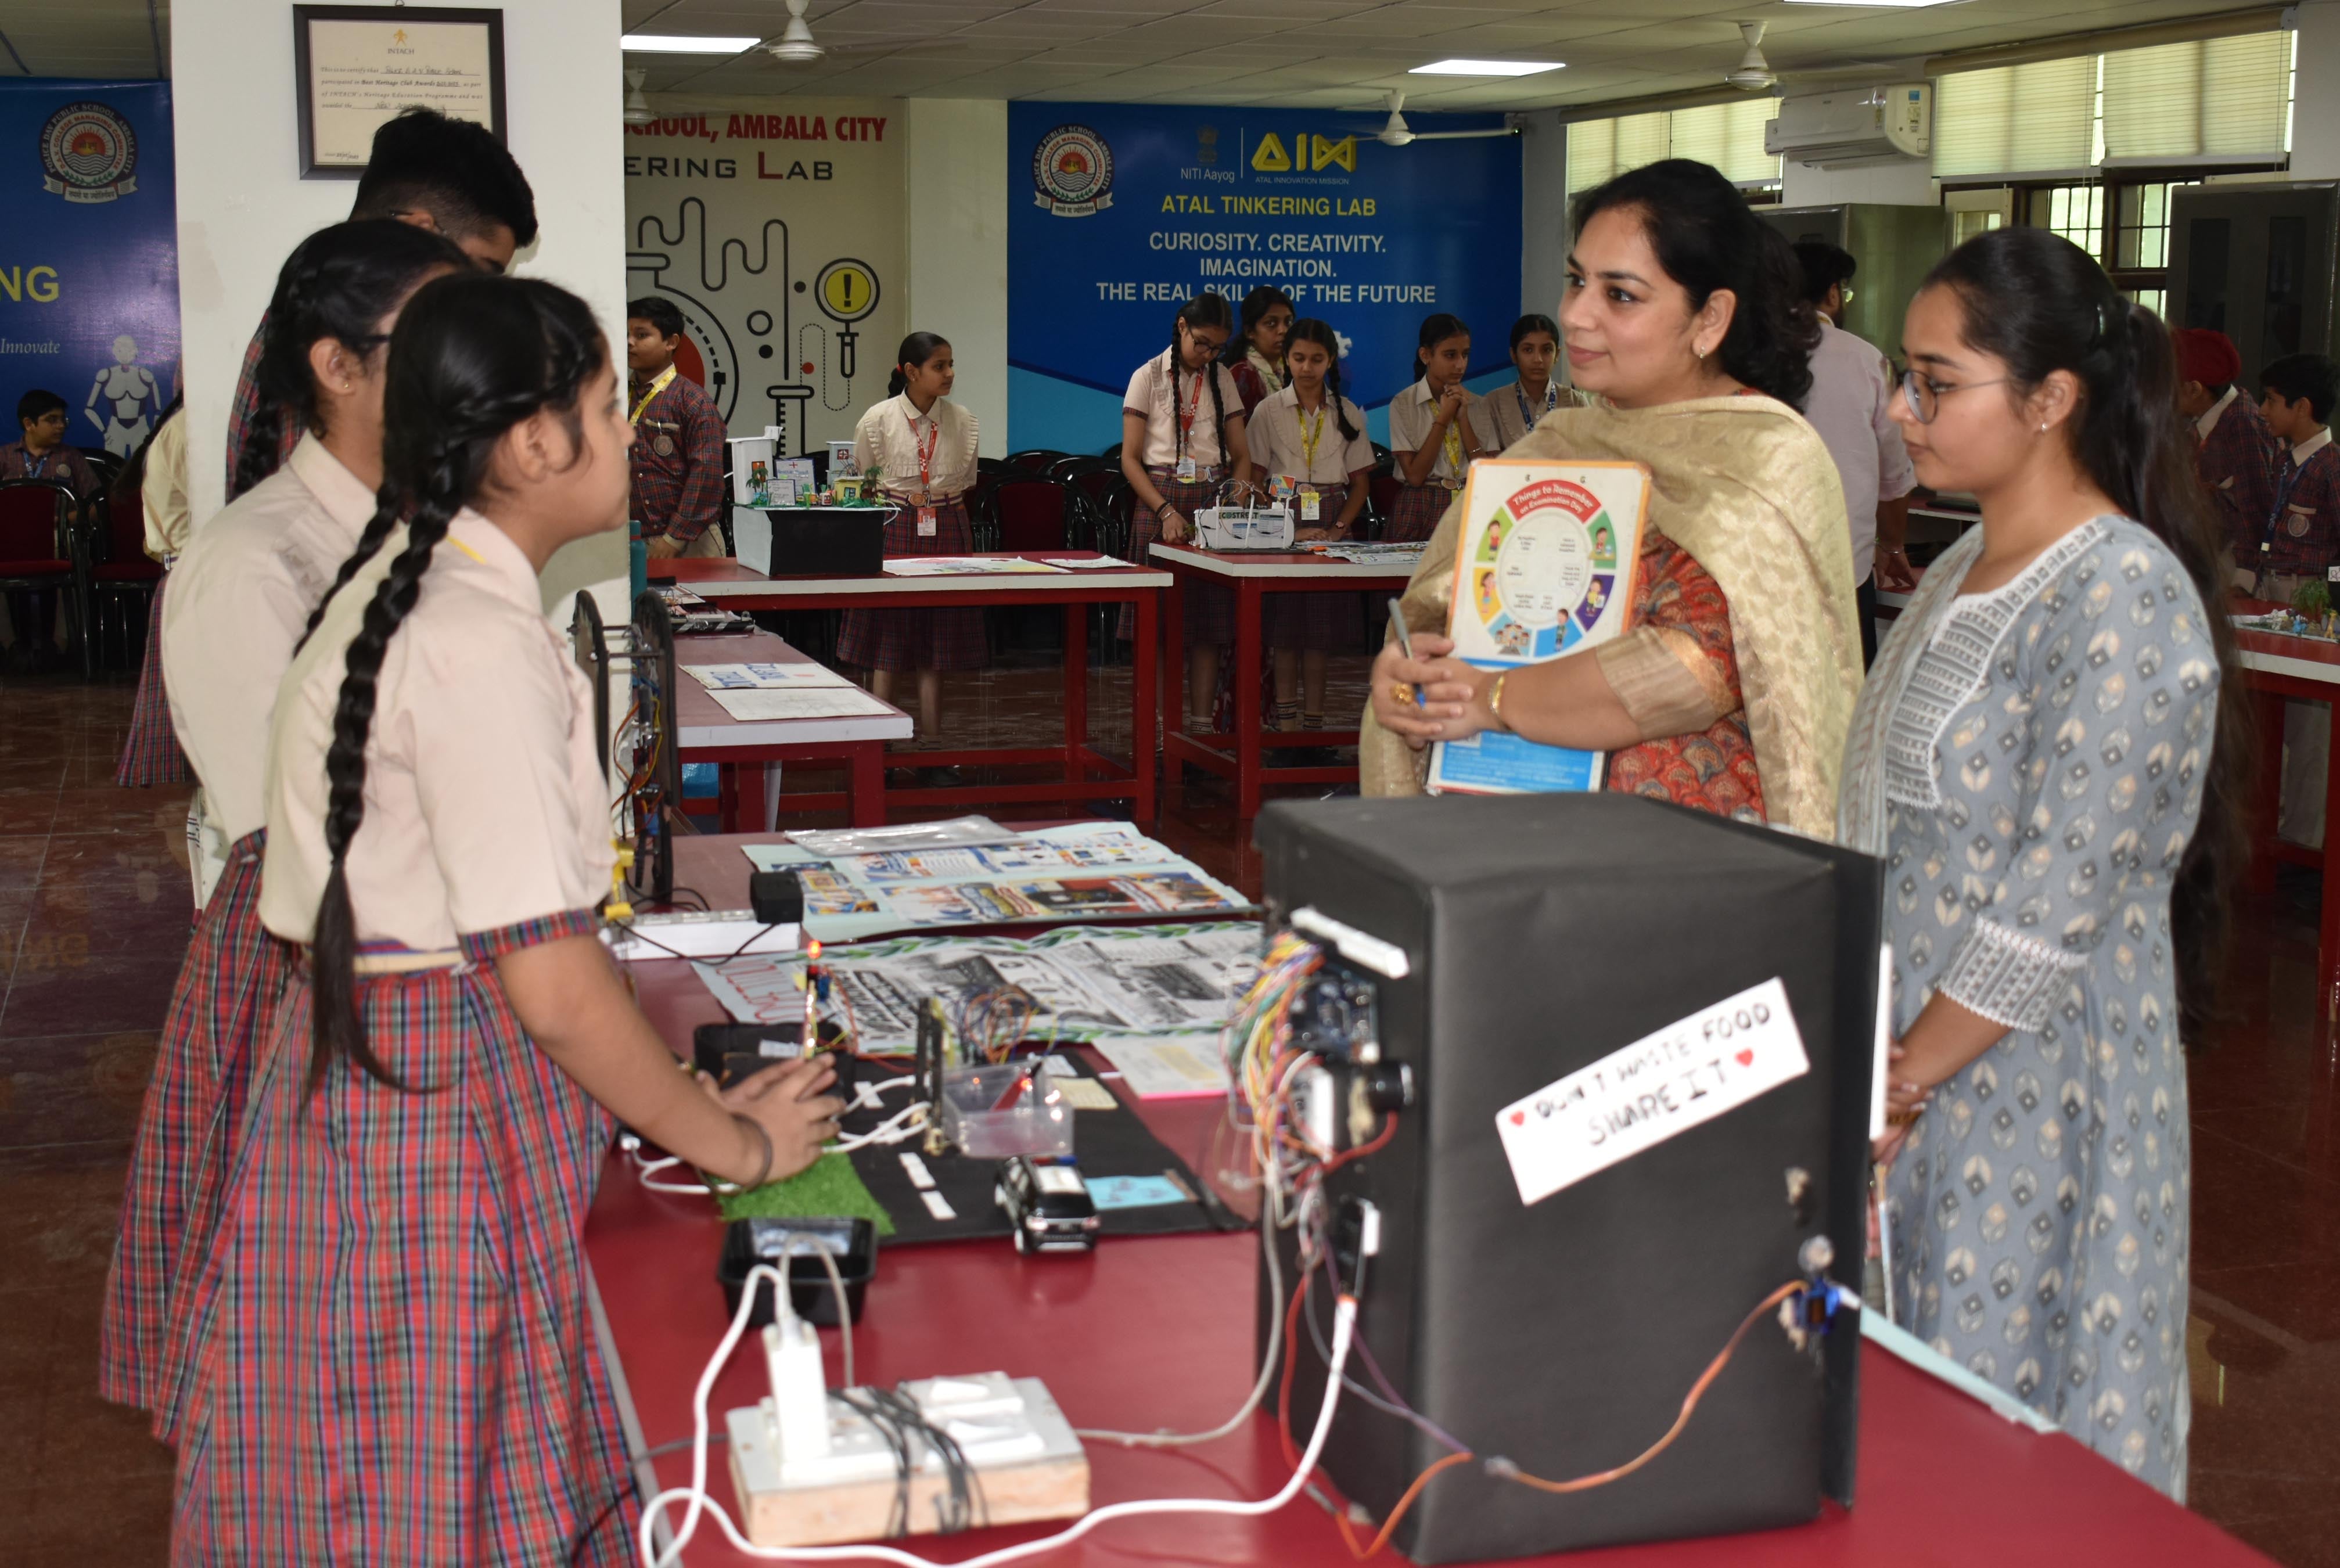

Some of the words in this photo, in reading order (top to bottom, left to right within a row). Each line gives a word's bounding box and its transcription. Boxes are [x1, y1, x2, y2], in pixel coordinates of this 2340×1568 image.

[51, 104, 80, 125] PUBLIC
[43, 123, 53, 141] DAV
[117, 120, 135, 153] AMBALA
[624, 112, 720, 143] HOOL,
[727, 114, 828, 141] AMBALA
[835, 116, 887, 142] CITY
[1043, 127, 1067, 145] PUBLIC
[53, 120, 74, 147] COLLEGE
[74, 114, 112, 128] MANAGING
[113, 129, 124, 170] COMMITTEE
[1035, 145, 1044, 160] DAV
[42, 142, 56, 174] POLICE
[124, 154, 135, 174] CITY
[1043, 141, 1060, 167] COLLEGE
[1062, 135, 1094, 149] MANAGING
[1093, 149, 1103, 187] COMMITTEE
[1097, 141, 1112, 171] AMBALA
[1033, 161, 1045, 190] POLICE
[1101, 172, 1112, 191] CITY
[1181, 167, 1202, 180] NITI
[1203, 168, 1235, 184] Aayog
[1162, 195, 1215, 214] ATAL
[1221, 196, 1330, 216] TINKERING
[1336, 198, 1376, 217] LAB
[1149, 232, 1262, 251] CURIOSITY.
[1268, 233, 1387, 253] CREATIVITY.
[1200, 258, 1338, 278] IMAGINATION.
[0, 265, 59, 303] NG
[1097, 282, 1137, 301] THE
[1143, 283, 1194, 301] REAL
[1203, 283, 1273, 302] SKIL
[1279, 284, 1307, 303] OF
[1313, 285, 1353, 303] THE
[1357, 285, 1436, 303] FUTURE
[0, 337, 61, 354] Innovate
[1512, 488, 1542, 506] Things
[1542, 486, 1552, 495] to
[1552, 484, 1594, 509] Remember
[1519, 505, 1529, 515] on
[1529, 497, 1570, 509] Examination
[1569, 501, 1584, 513] Day
[1533, 1071, 1608, 1120] DONT
[1702, 1001, 1771, 1044] FOOD
[1588, 1083, 1680, 1146] SHARE
